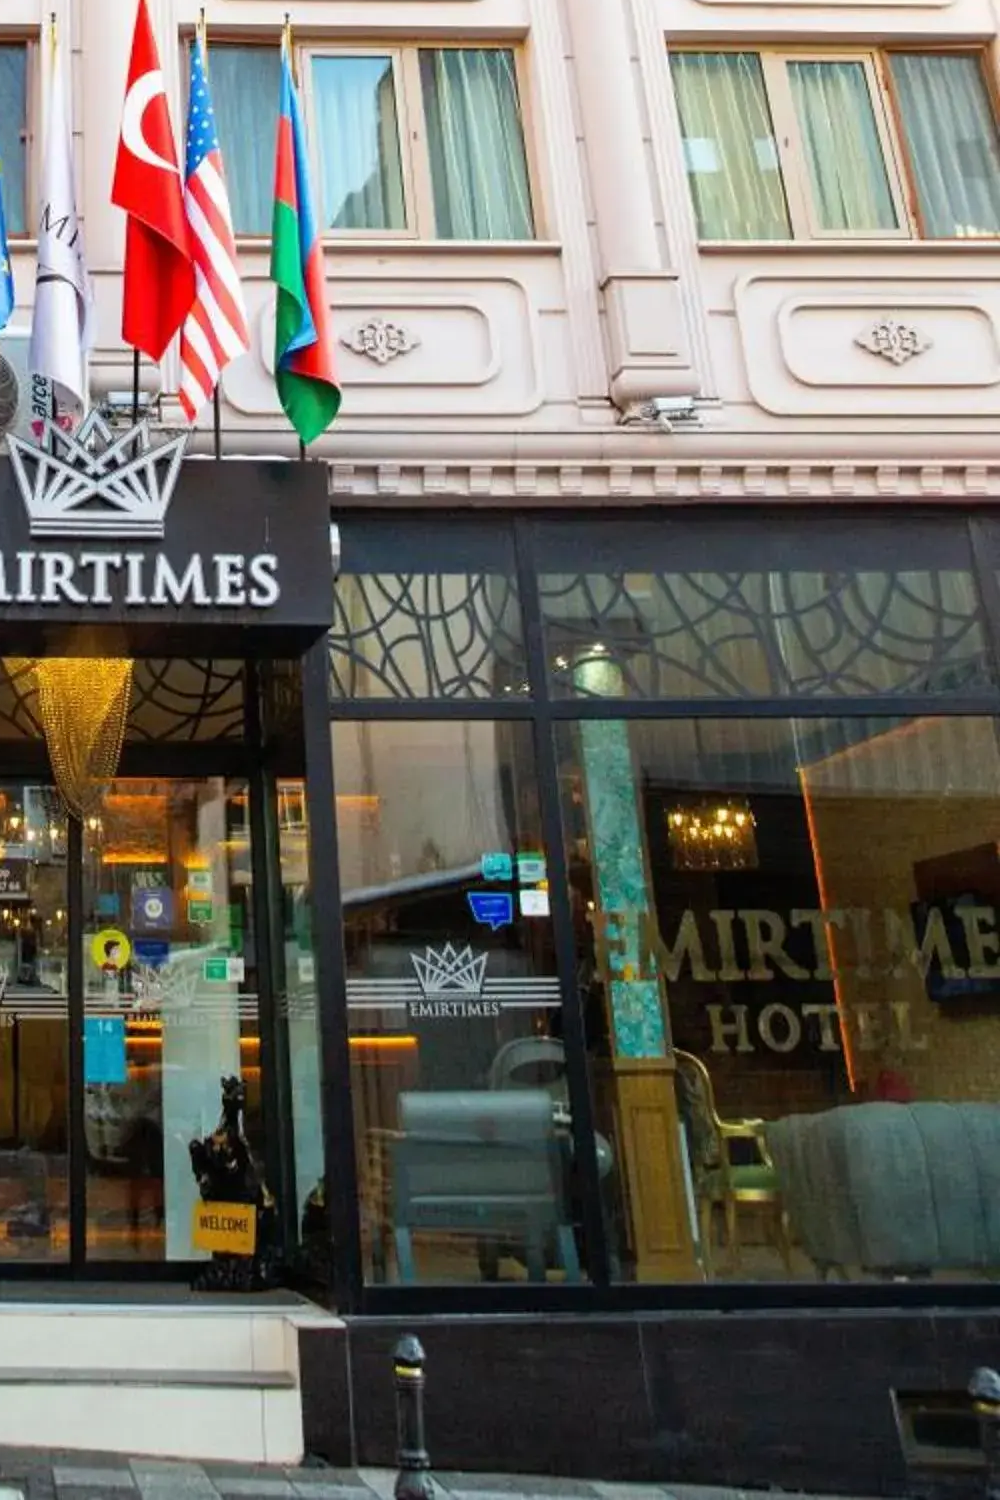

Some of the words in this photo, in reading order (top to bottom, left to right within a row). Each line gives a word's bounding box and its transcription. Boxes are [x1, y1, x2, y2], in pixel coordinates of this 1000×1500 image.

[588, 906, 1000, 982] EMIRTIME
[410, 1001, 499, 1017] EMIRTIMES
[704, 1002, 928, 1053] HOTEL
[200, 1214, 249, 1233] WELCOME
